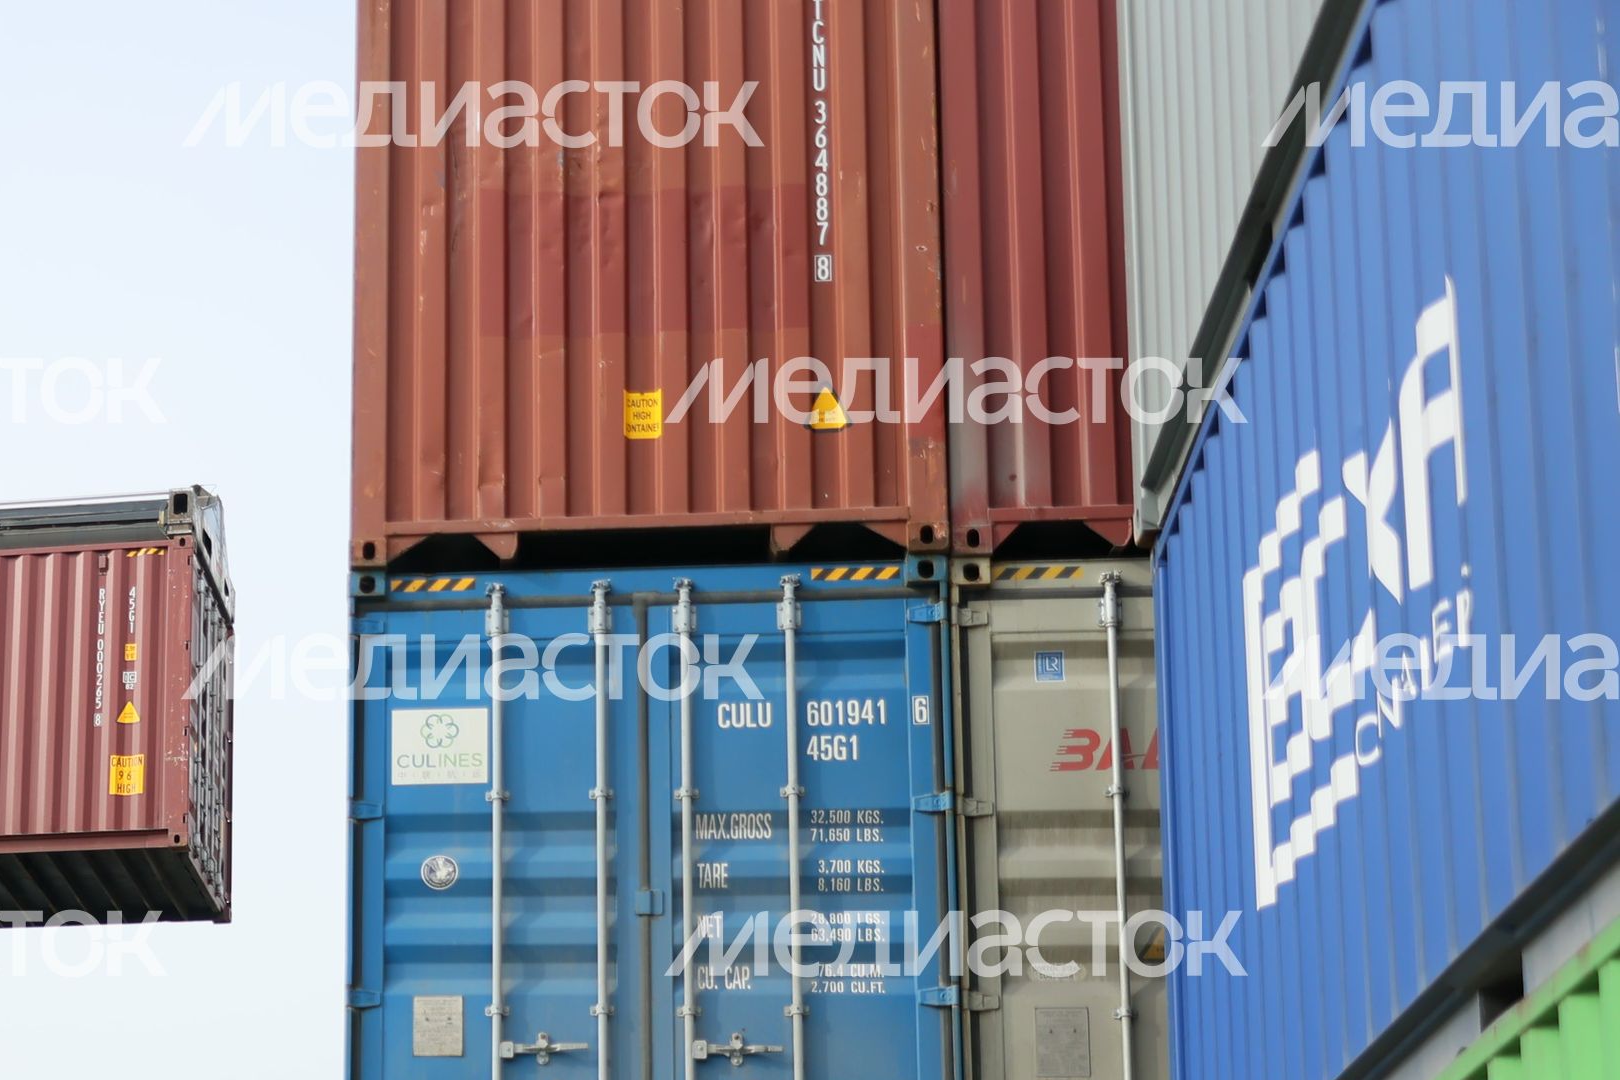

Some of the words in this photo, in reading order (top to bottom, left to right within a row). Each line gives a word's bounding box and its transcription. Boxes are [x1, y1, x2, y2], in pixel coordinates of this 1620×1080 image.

[813, 100, 829, 246] 364887
[817, 257, 830, 281] 8
[632, 411, 652, 420] HIGH
[97, 588, 106, 635] RYEU
[128, 586, 137, 634] 45G1
[717, 702, 772, 728] CULU
[806, 699, 886, 727] 601941
[914, 697, 928, 724] 6
[396, 752, 483, 769] CULINES
[806, 734, 859, 761] 45G1
[695, 812, 772, 840] MAX.GROSS
[856, 809, 884, 825] KGS.
[856, 828, 884, 843] LBS.
[696, 863, 728, 888] TARE
[857, 859, 885, 875] KGS.
[856, 877, 884, 893] LBS.
[696, 915, 723, 939] NET
[724, 965, 751, 990] CAP.
